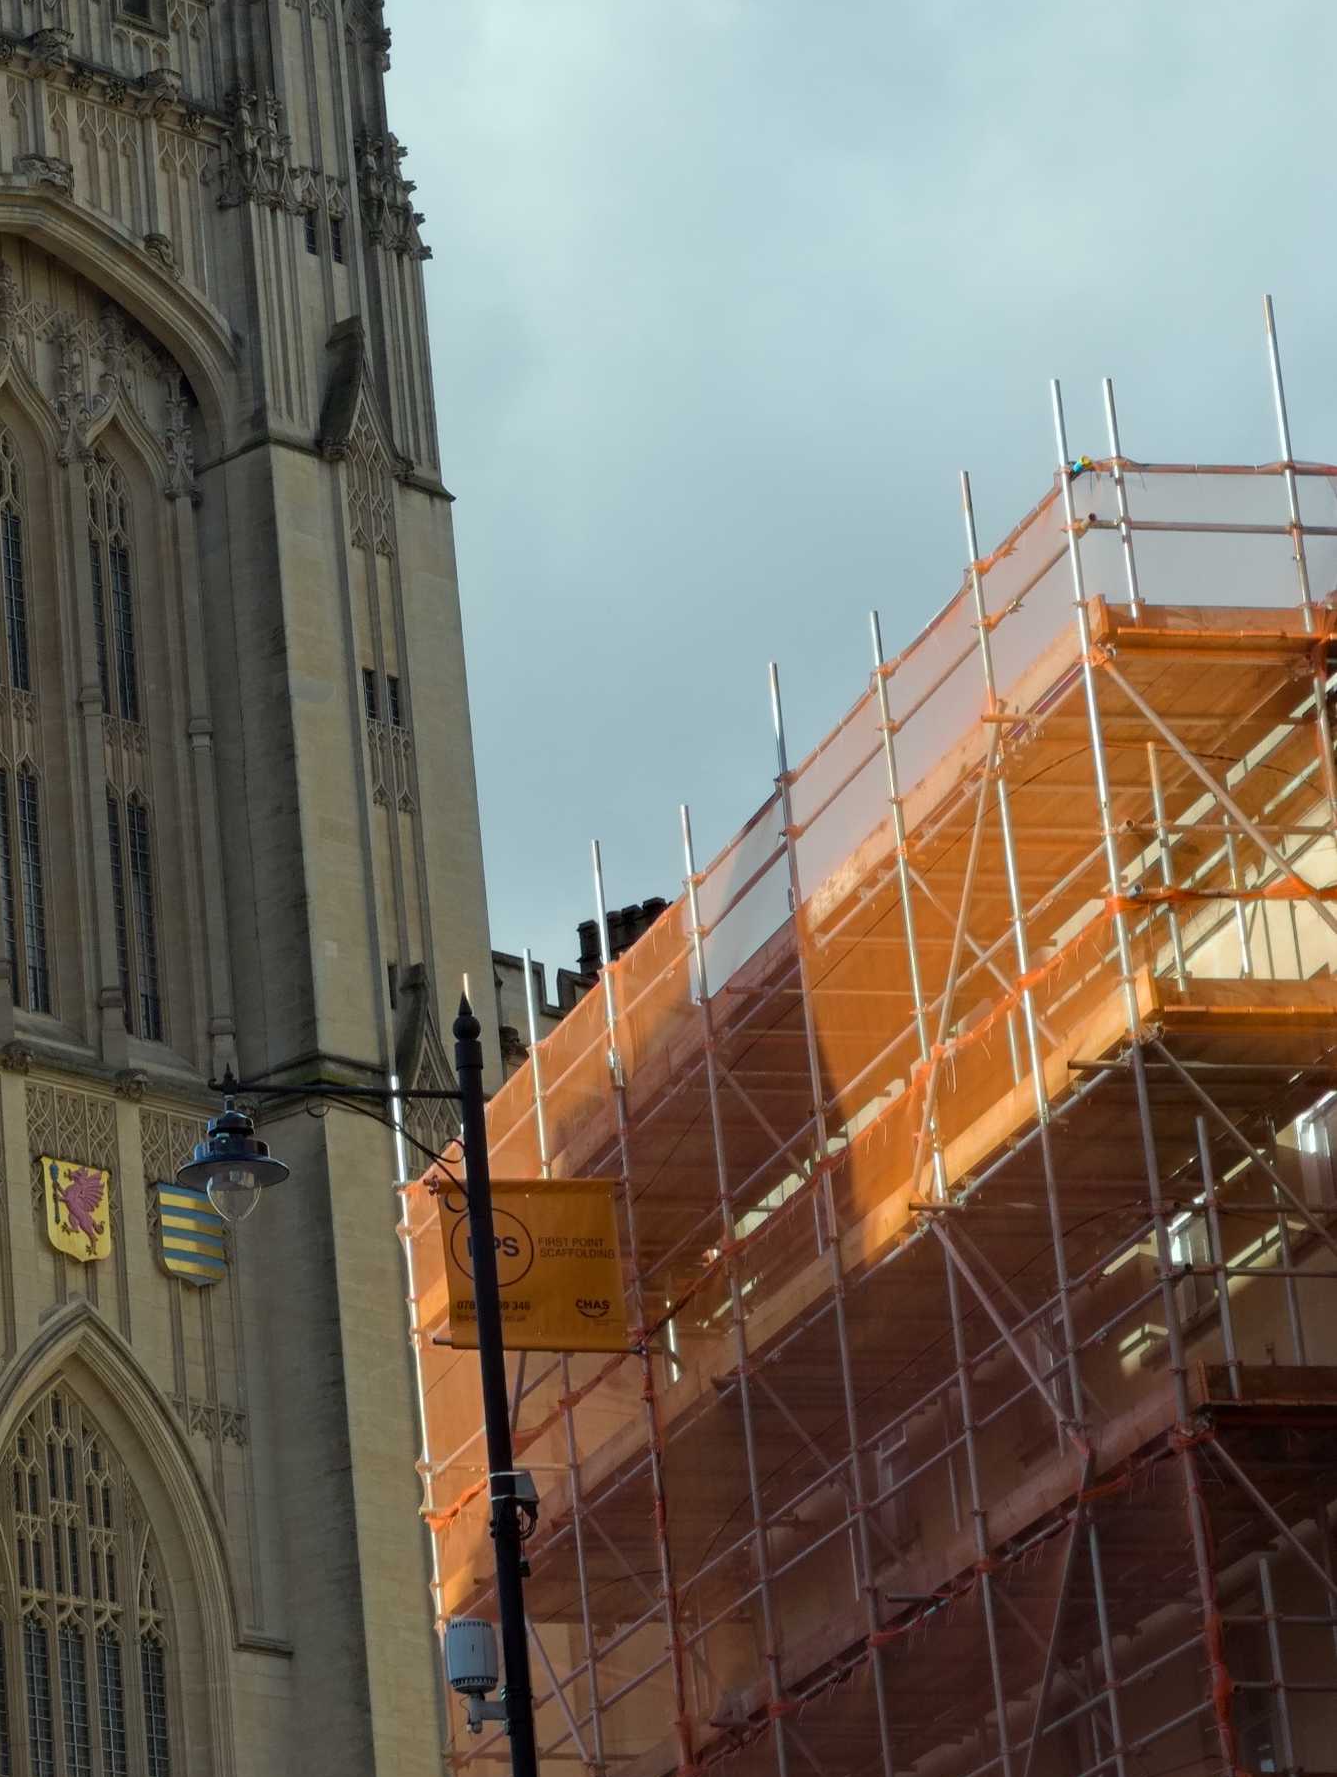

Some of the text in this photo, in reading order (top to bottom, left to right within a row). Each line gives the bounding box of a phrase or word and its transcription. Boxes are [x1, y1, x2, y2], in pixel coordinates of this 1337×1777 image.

[538, 1237, 605, 1247] FIRST POINT
[539, 1248, 615, 1259] SCAFFOLDING
